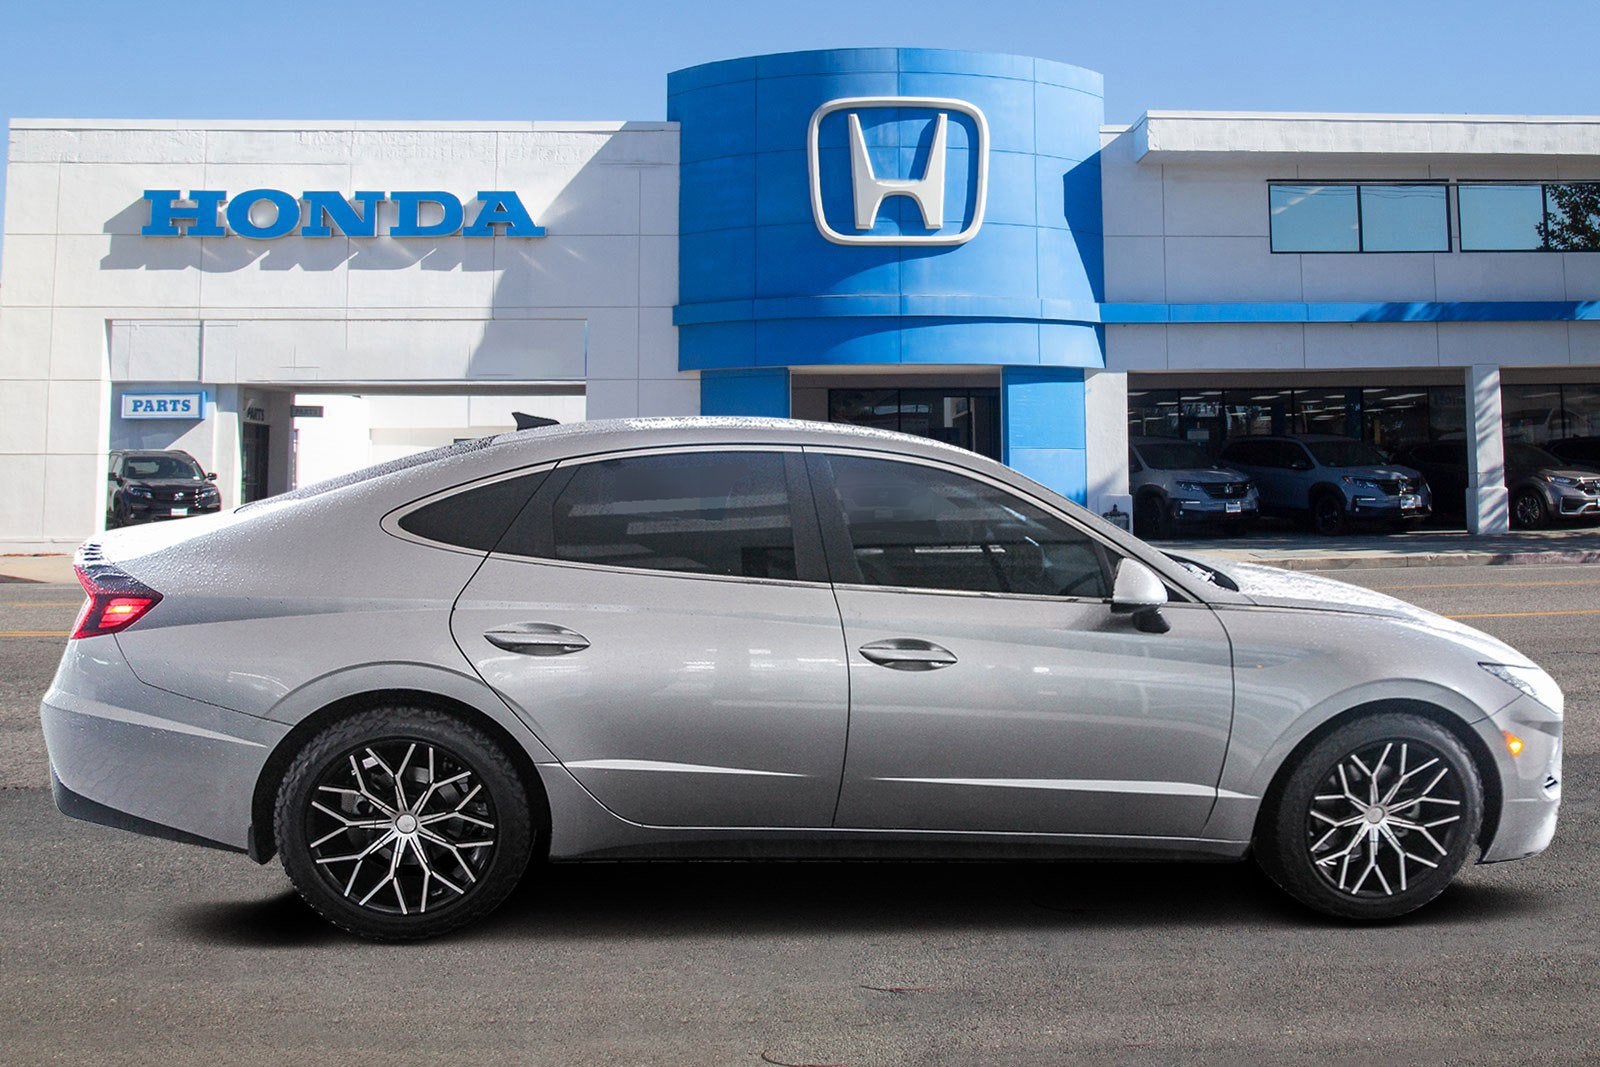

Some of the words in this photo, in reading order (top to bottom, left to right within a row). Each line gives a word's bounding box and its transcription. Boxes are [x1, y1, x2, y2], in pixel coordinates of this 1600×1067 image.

[141, 189, 546, 239] HONDA
[132, 399, 191, 412] PARTS
[247, 407, 264, 421] PARTS
